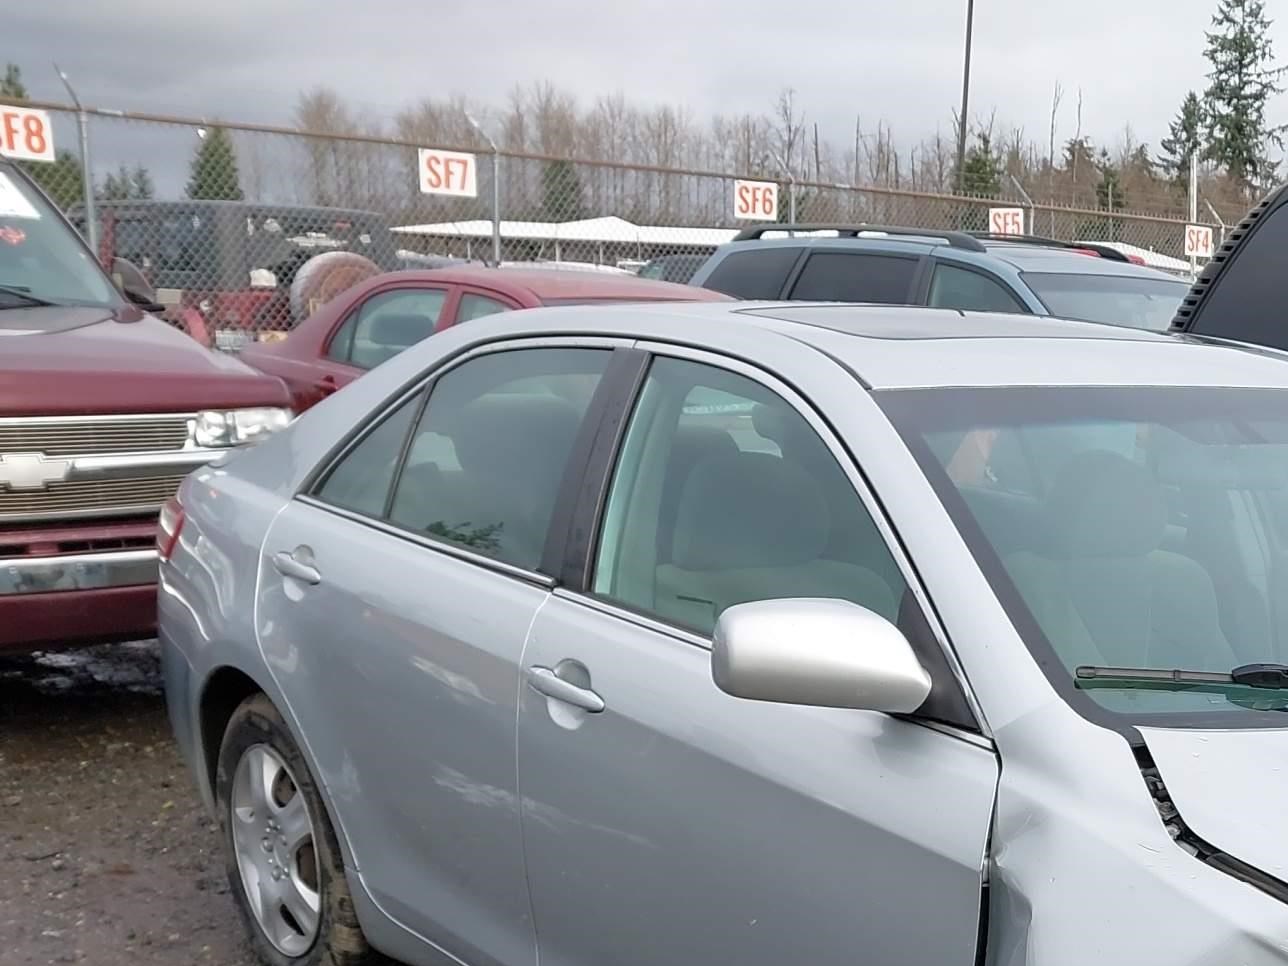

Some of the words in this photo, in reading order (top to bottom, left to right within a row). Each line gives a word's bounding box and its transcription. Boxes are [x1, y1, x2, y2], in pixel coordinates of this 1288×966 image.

[0, 112, 46, 154] F8
[426, 155, 468, 191] SF7
[738, 185, 773, 215] SF6
[993, 212, 1020, 234] SF5
[1188, 229, 1209, 253] SF4
